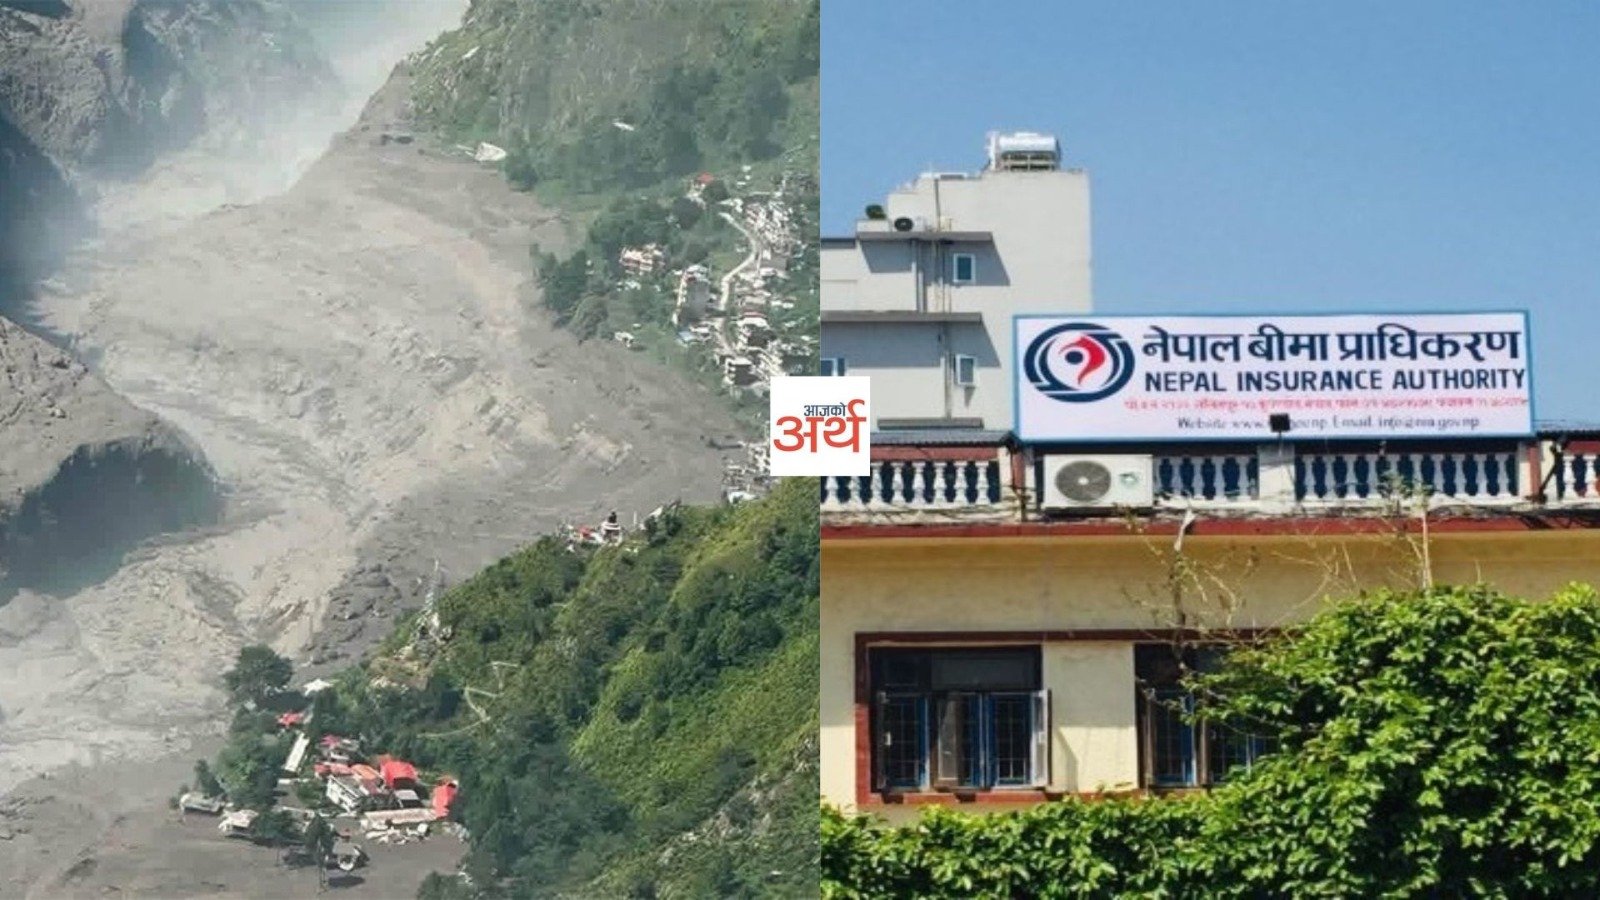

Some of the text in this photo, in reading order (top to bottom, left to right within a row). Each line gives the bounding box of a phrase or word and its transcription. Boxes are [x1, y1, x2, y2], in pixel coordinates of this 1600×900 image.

[1142, 323, 1522, 362] नेपाल बीमा प्राधिकरण
[1145, 368, 1526, 391] NEPAL INSURANCE AUTHORITY
